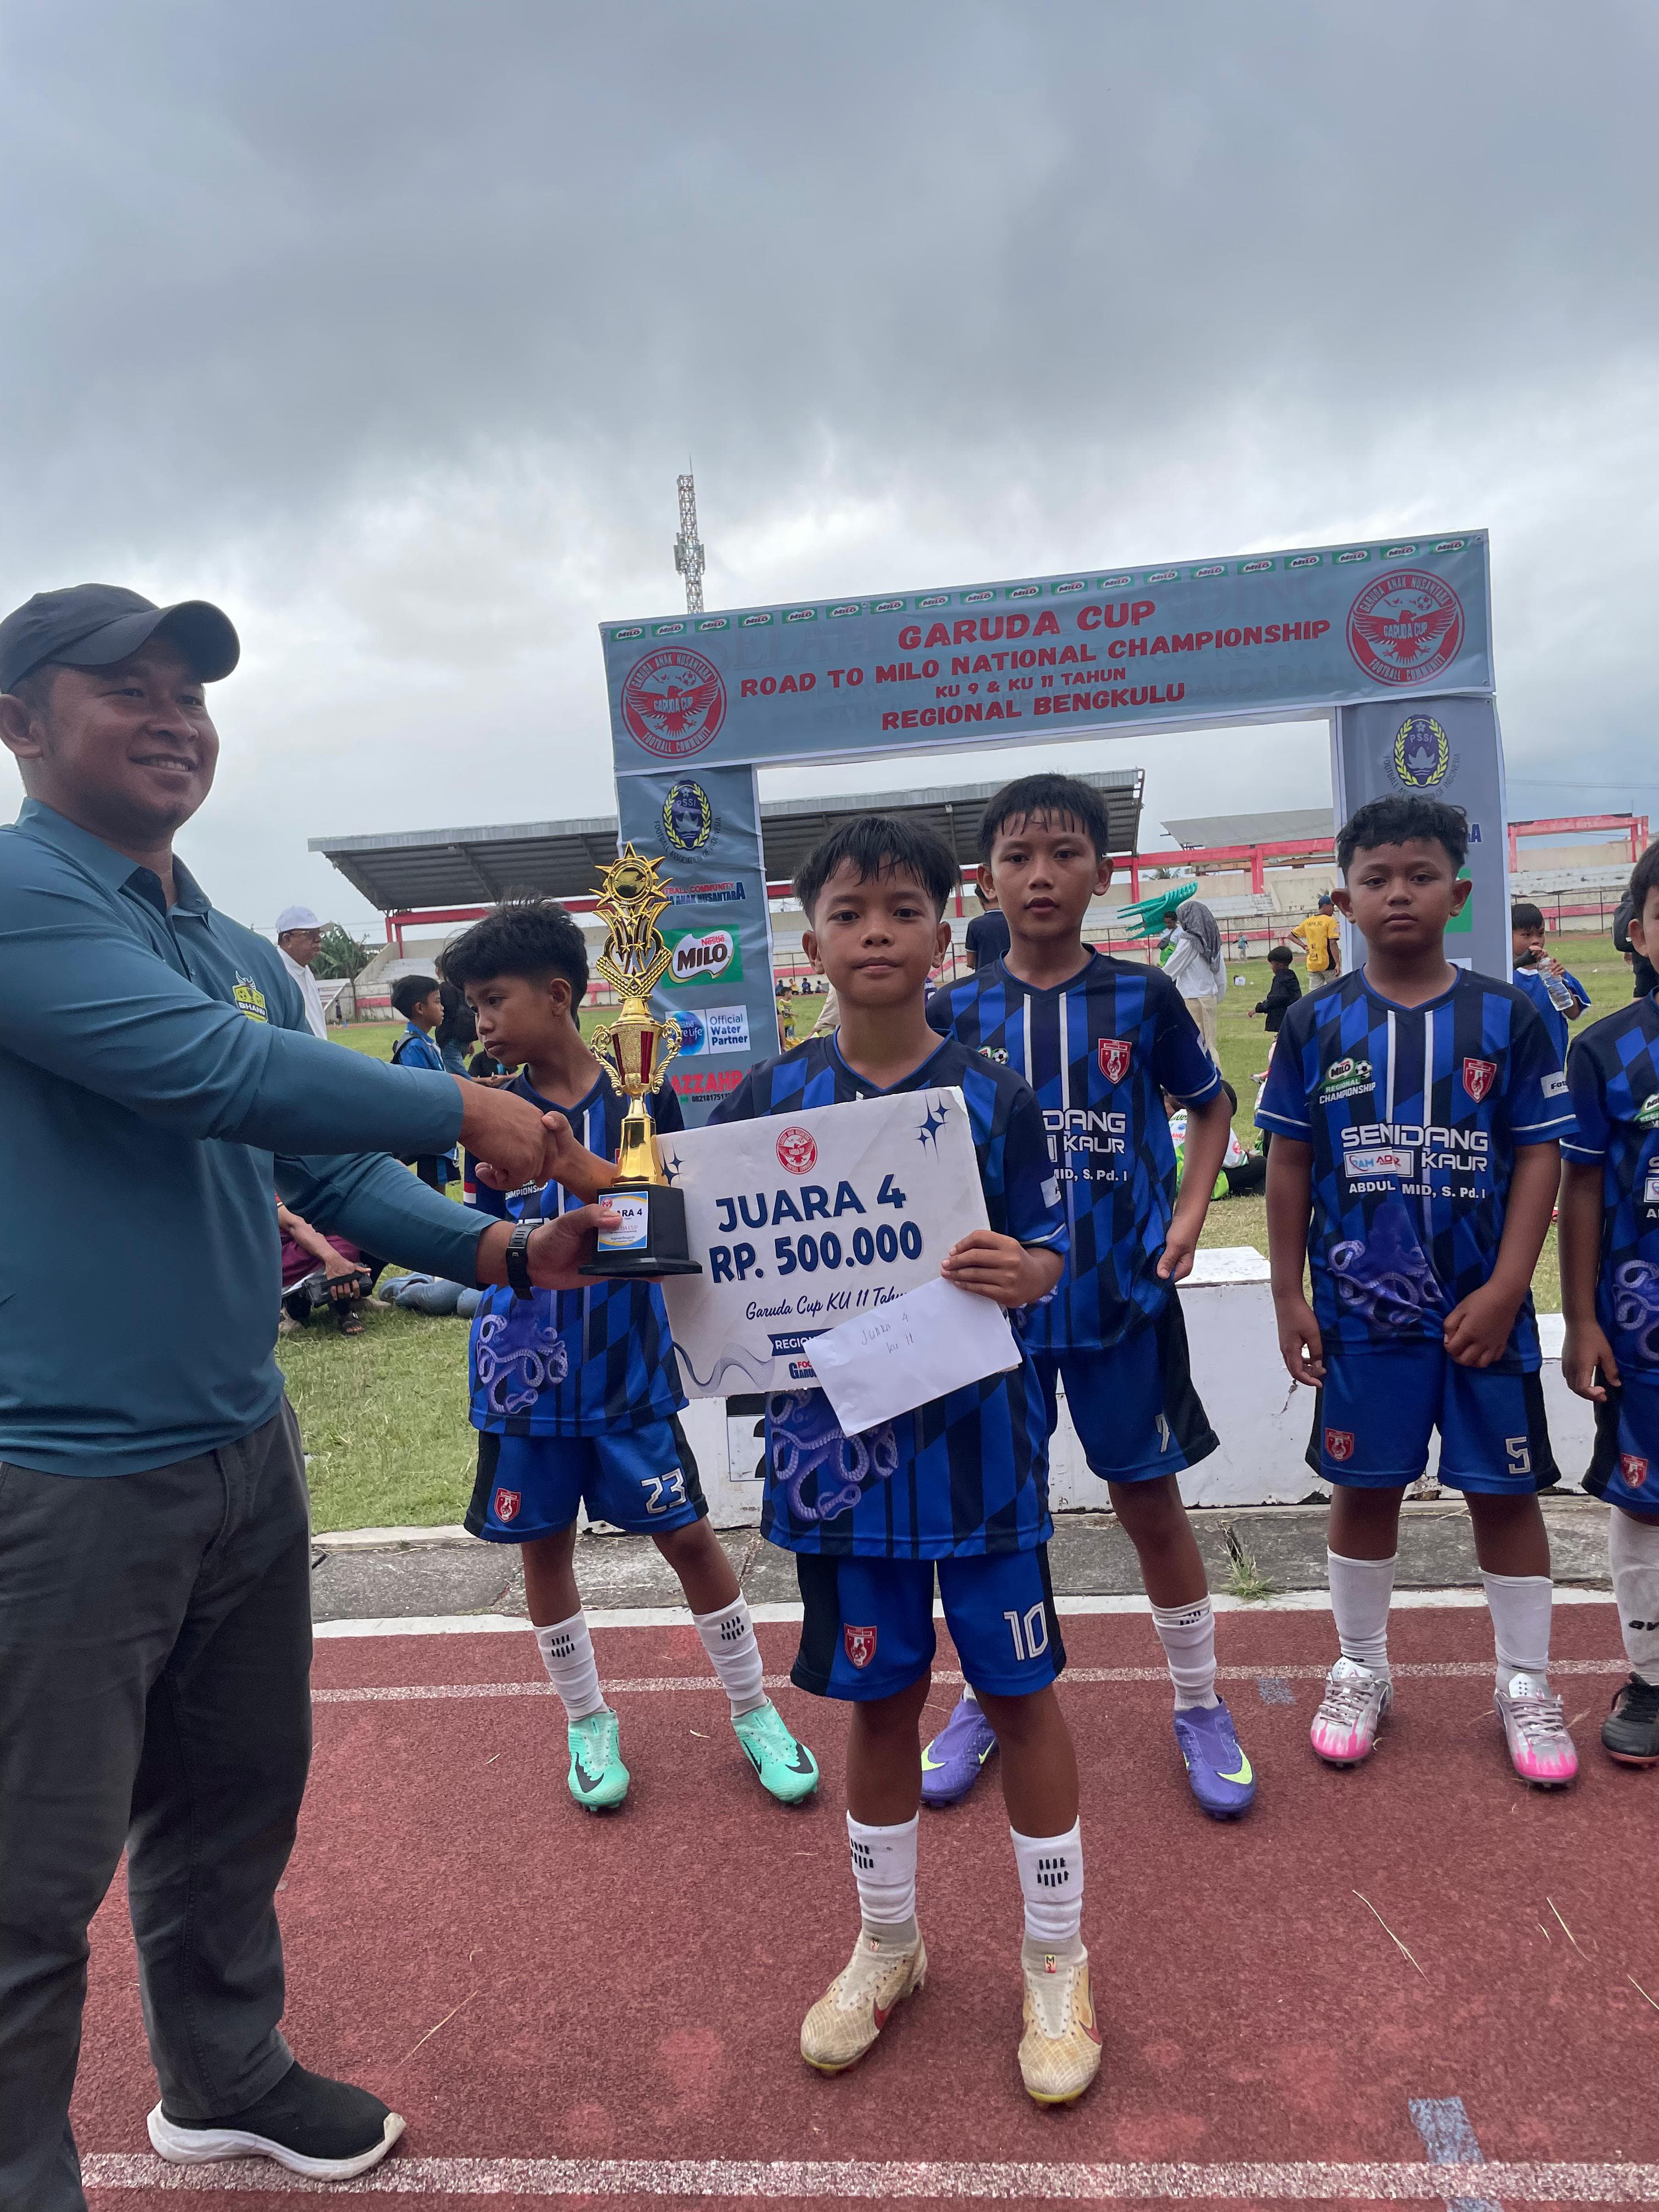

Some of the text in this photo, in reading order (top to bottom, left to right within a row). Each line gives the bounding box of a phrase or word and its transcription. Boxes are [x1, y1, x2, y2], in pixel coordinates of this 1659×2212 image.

[618, 630, 640, 638] MILO
[659, 626, 681, 634] MILO
[1059, 584, 1082, 592] MILO
[1152, 572, 1175, 580] MILO
[1198, 568, 1222, 576] MILO
[1245, 563, 1269, 571] MILO
[1293, 557, 1317, 567] MILO
[1359, 586, 1385, 612] GARUDA
[1411, 577, 1450, 605] NUSANTARA
[898, 610, 1060, 650] GARUDA
[1077, 601, 1156, 631] CUP
[1384, 622, 1427, 639] GARUDA CUP
[631, 663, 653, 687] GARUDA
[676, 654, 712, 680] NUSANTARA
[741, 619, 1330, 698] ROAD TO MILO NATIONAL CHAMPIONSHIP
[1368, 653, 1446, 680] FOOTBALL COMMUNITY
[936, 667, 1126, 699] KU 9 & KU 11 TAHUN
[654, 697, 693, 713] GARUDA CUP
[882, 699, 1021, 730] REGIONAL
[1033, 682, 1185, 715] BENGKULU
[642, 725, 711, 752] FOOTBALL COMMUNITY
[1410, 733, 1432, 743] PSSI
[1383, 756, 1398, 789] FOOTBALL
[1444, 753, 1460, 788] INDONESIA
[676, 799, 696, 808] PSSI
[690, 882, 734, 893] COMMUNITY
[697, 882, 746, 904] NUSANTARA
[678, 944, 727, 971] MILO
[710, 1014, 743, 1025] Official
[710, 1026, 741, 1035] Water
[689, 1028, 703, 1040] Life
[712, 1035, 748, 1046] Partner
[1331, 1064, 1351, 1077] MILO
[1319, 1082, 1376, 1104] CHAMPIONSHIP
[1325, 1079, 1360, 1093] REGIONAL
[1042, 1109, 1126, 1133] DANG
[1063, 1136, 1125, 1154] KAUR
[1421, 1152, 1487, 1171] KAUR
[1349, 1181, 1396, 1193] ABDUL
[715, 1174, 906, 1233] JUARA 4
[709, 1221, 922, 1283] RP. 500.000
[746, 1299, 793, 1319] Garuda
[797, 1295, 823, 1317] Cup
[827, 1291, 851, 1311] KU
[856, 1289, 869, 1307] 11
[901, 1312, 909, 1323] 4
[905, 1333, 914, 1345] 11
[1505, 1436, 1531, 1474] 5
[641, 1468, 687, 1514] 23
[1003, 1601, 1049, 1661] 10
